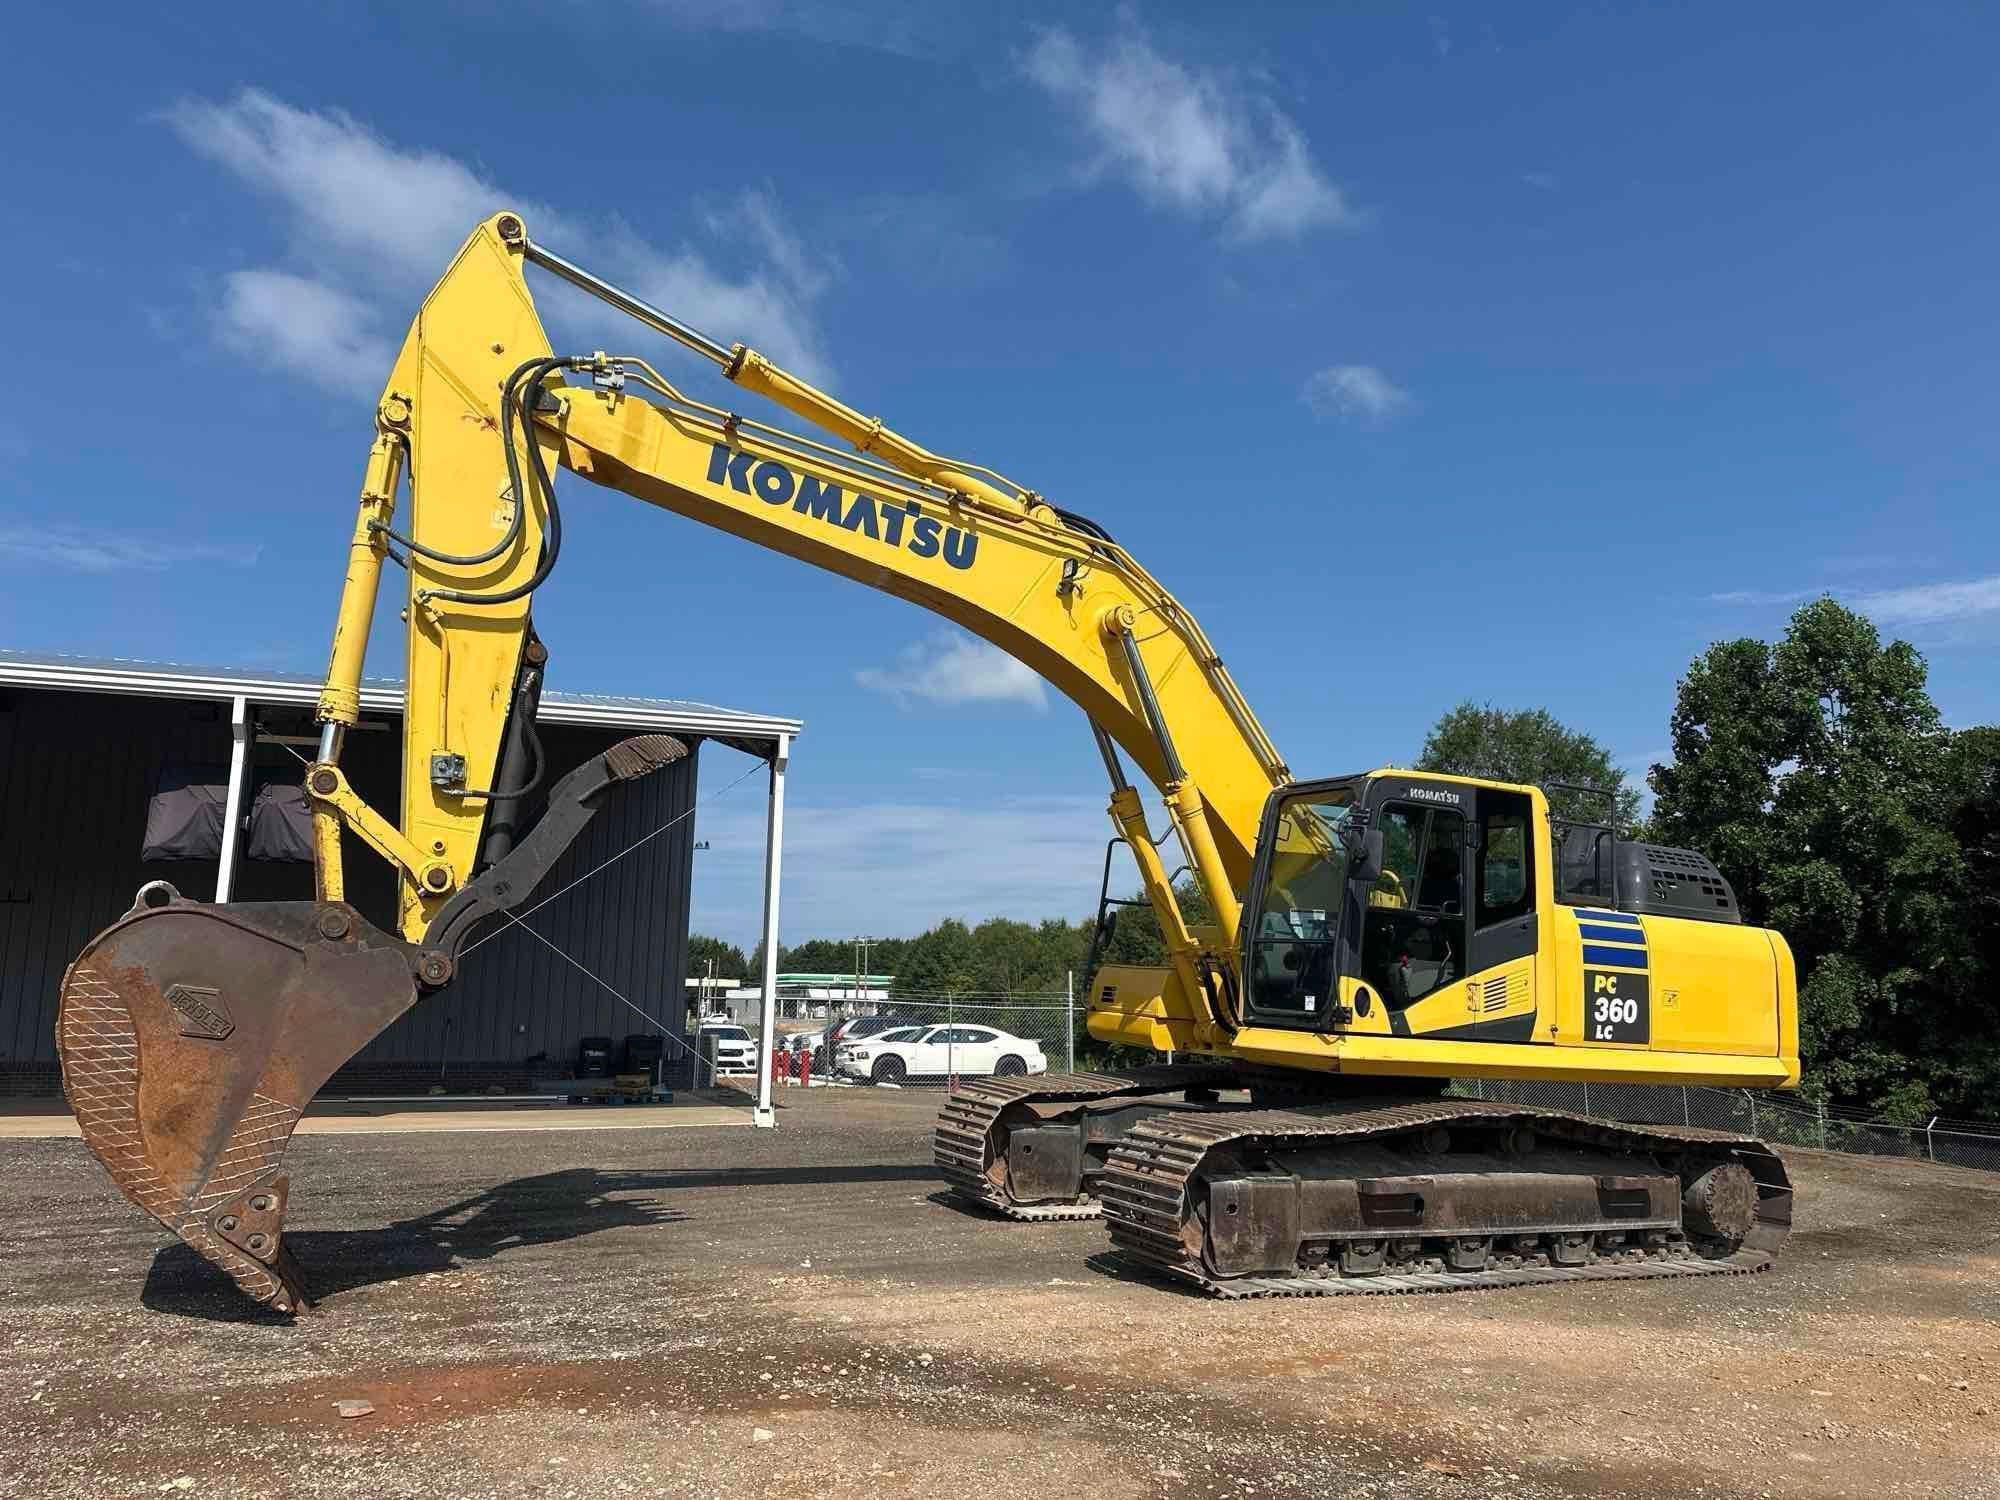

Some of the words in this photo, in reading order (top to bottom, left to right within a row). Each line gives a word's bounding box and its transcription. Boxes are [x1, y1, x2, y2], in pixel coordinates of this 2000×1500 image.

[706, 441, 979, 570] KOMATSU
[1409, 787, 1460, 804] KOMATSU
[1594, 974, 1617, 994] PC
[1594, 996, 1638, 1024] 360
[1595, 1024, 1614, 1040] LC
